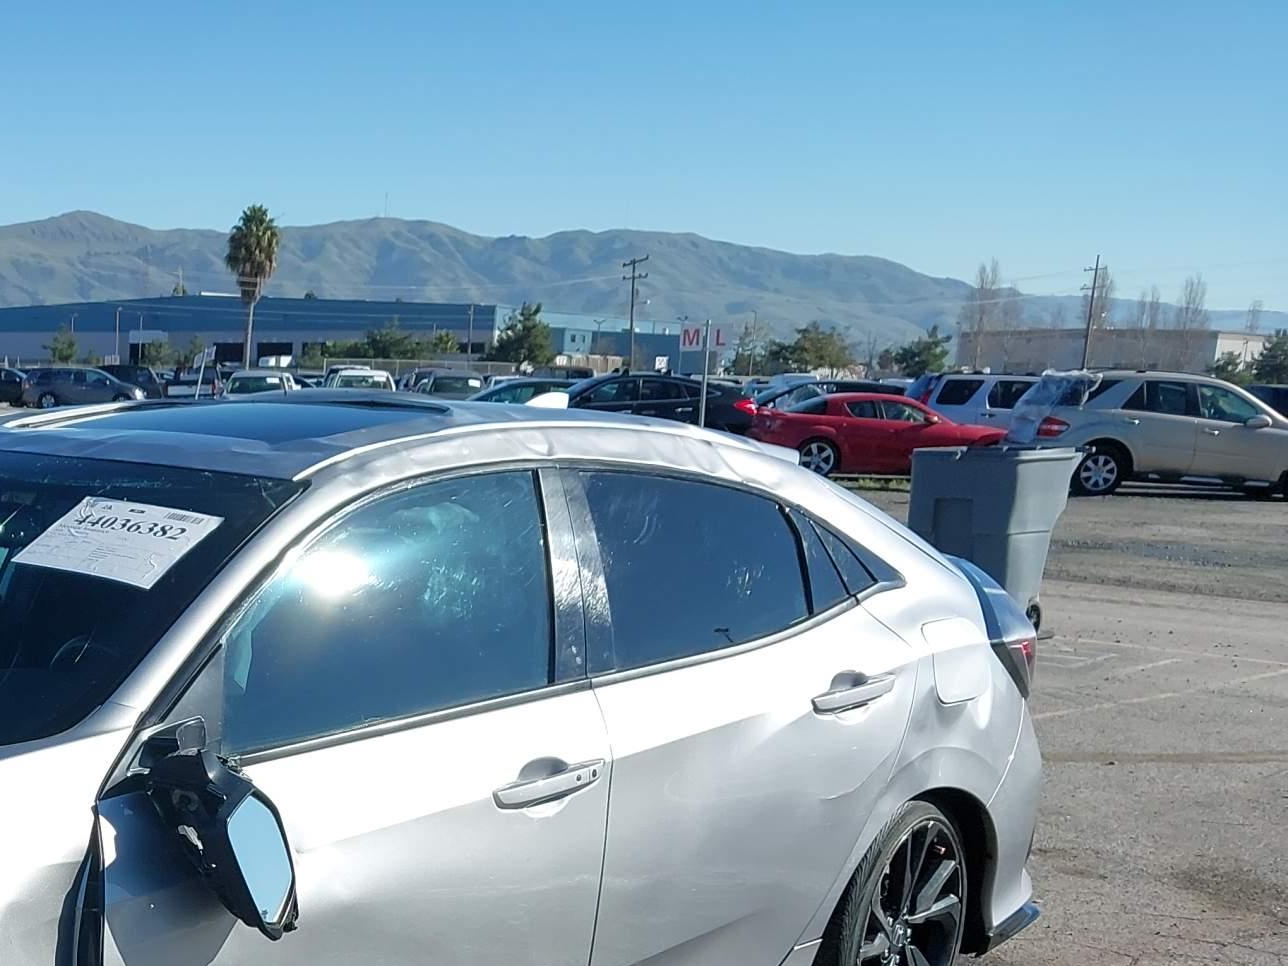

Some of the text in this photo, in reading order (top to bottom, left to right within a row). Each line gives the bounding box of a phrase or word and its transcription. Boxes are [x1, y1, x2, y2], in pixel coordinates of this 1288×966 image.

[683, 328, 726, 346] M L
[74, 514, 187, 541] 44036382
